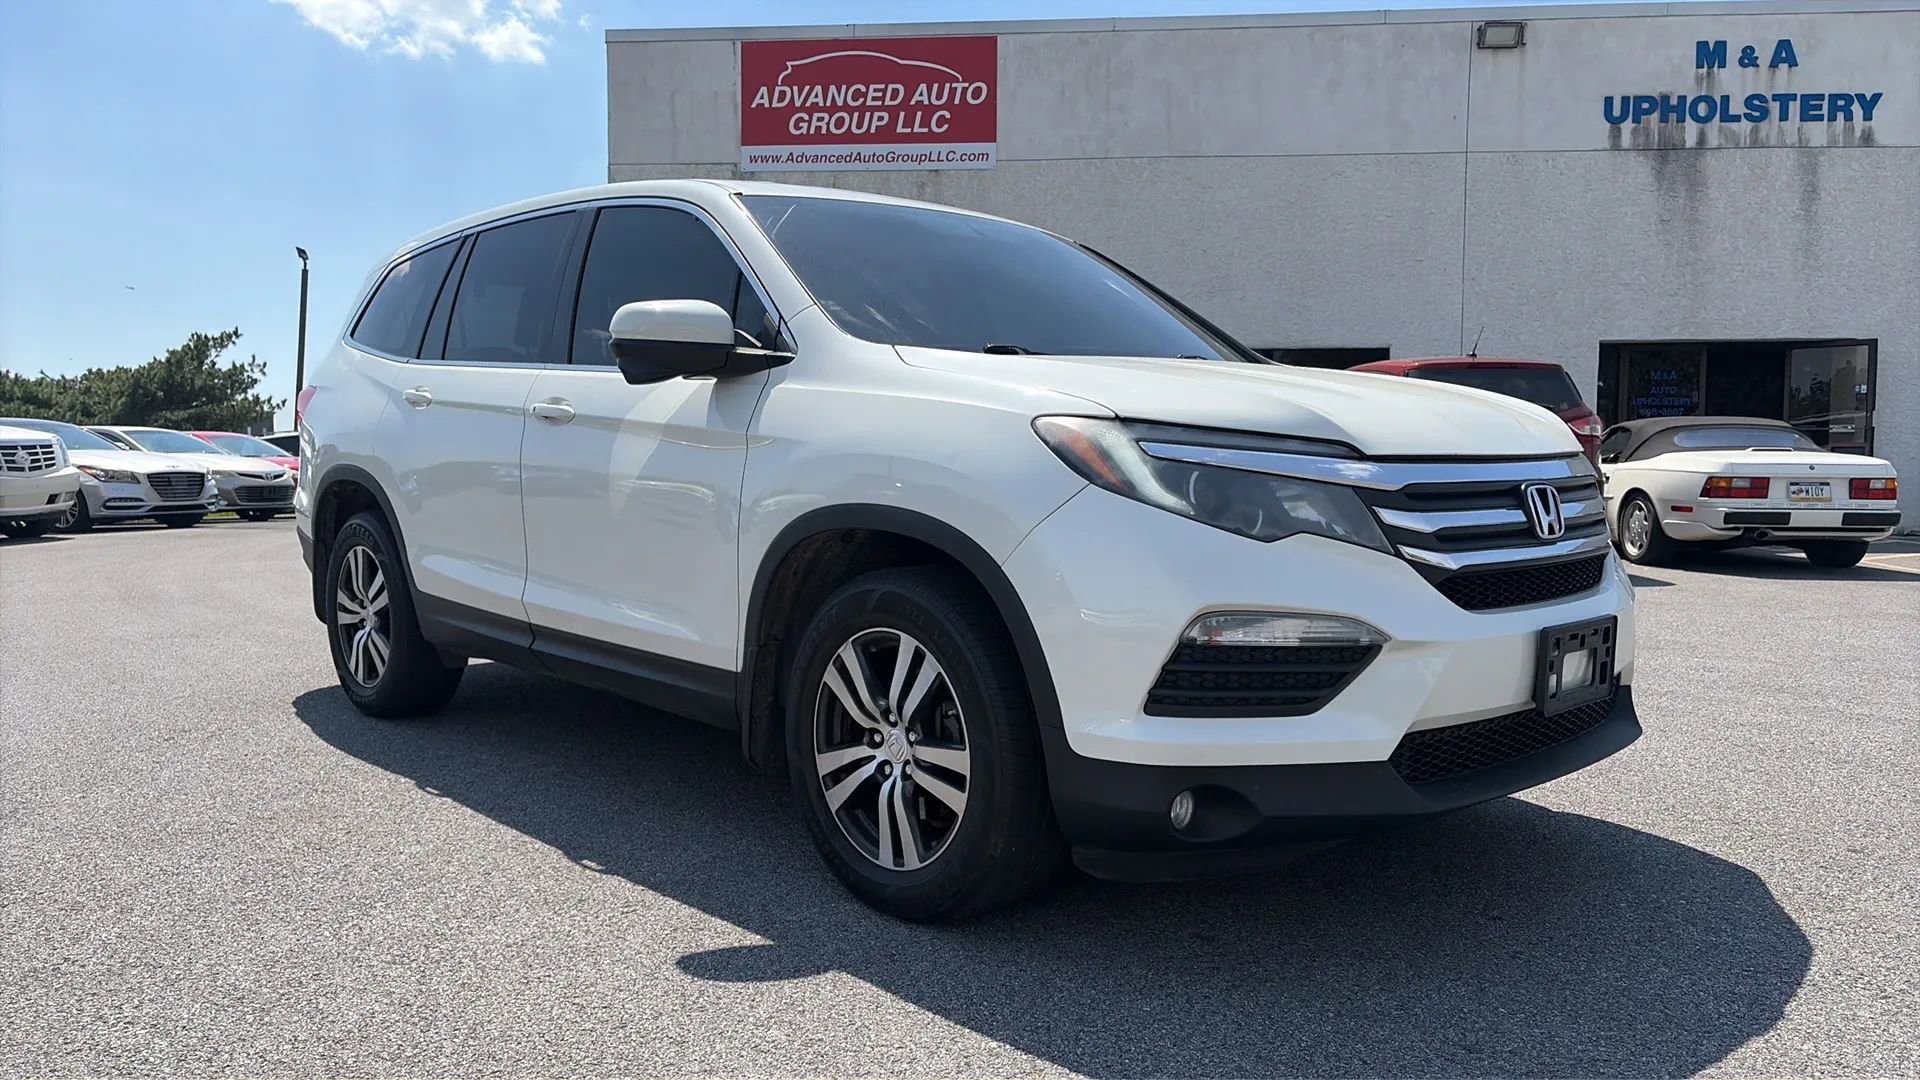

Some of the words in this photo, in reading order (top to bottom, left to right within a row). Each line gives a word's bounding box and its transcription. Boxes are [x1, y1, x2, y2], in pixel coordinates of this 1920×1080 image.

[1695, 40, 1727, 69] M
[1738, 45, 1760, 68] &
[1769, 39, 1799, 68] A
[751, 84, 904, 108] ADVANCED
[909, 81, 988, 105] AUTO
[1603, 92, 1883, 125] UPHOLSTERY
[788, 111, 889, 135] GROUP
[896, 110, 951, 134] LLC
[748, 150, 989, 165] www.AdvancedAutoGroupLLC.com
[1650, 386, 1677, 394] AUTO
